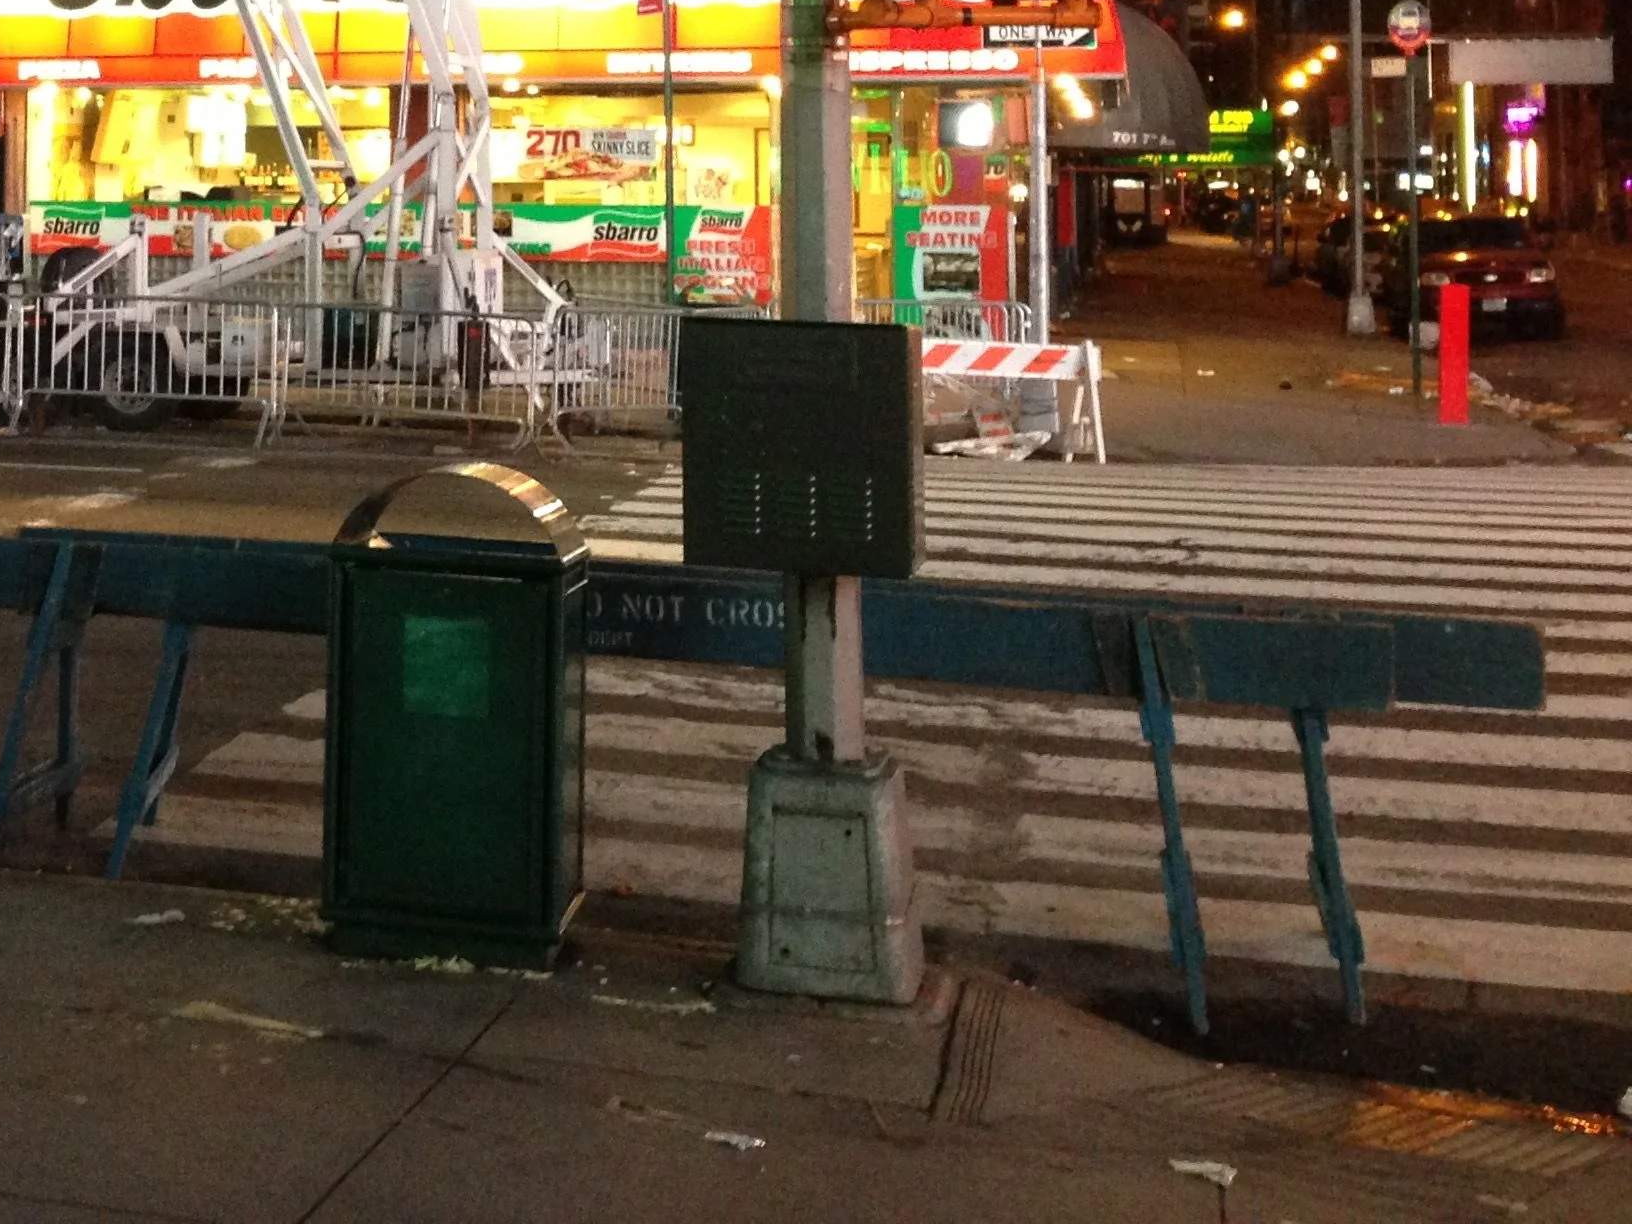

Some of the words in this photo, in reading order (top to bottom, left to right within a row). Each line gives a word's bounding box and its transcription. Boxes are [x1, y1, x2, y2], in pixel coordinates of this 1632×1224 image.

[998, 26, 1029, 39] ONE
[1044, 26, 1076, 38] WAY
[527, 130, 580, 156] 270
[1112, 132, 1136, 144] 701
[592, 140, 624, 154] SKINNY
[626, 141, 650, 156] SLICE
[43, 216, 100, 235] sbarro
[701, 214, 742, 228] sbarro
[921, 211, 980, 225] MORE
[594, 222, 657, 241] sbarro
[686, 239, 755, 255] FRESH
[906, 232, 998, 247] SEATING
[678, 257, 766, 272] ITALIAN
[622, 593, 684, 622] NOT
[706, 599, 784, 628] CRO
